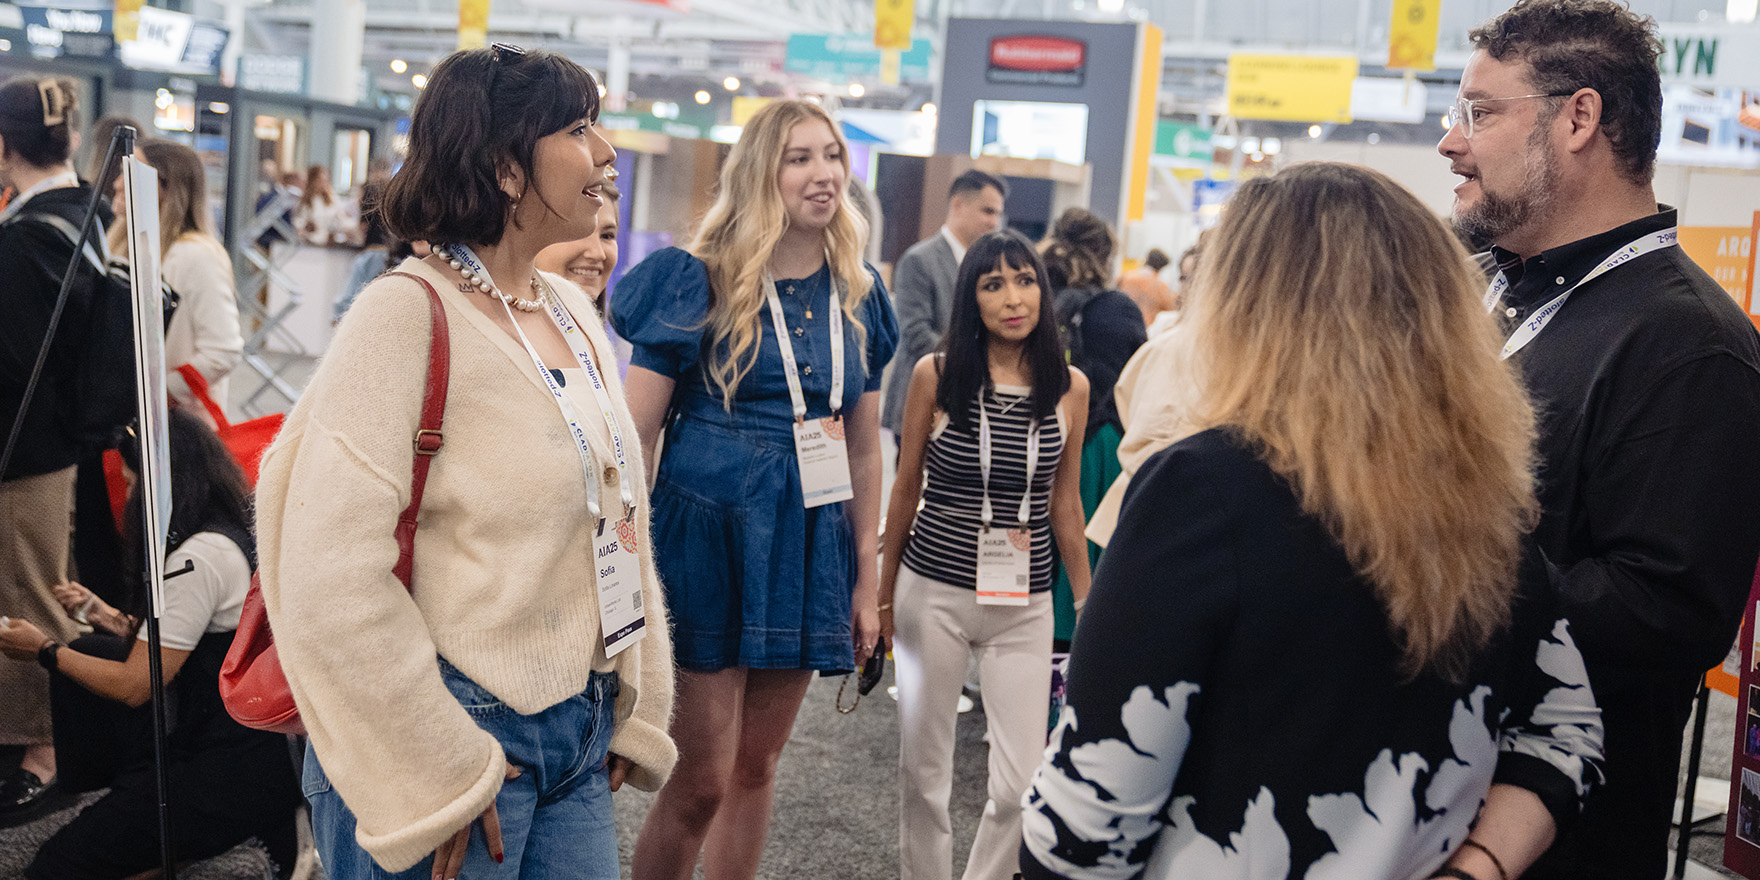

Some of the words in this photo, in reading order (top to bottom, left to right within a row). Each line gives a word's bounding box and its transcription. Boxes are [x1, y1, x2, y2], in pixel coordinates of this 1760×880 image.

[451, 244, 481, 274] Slotted-Z
[579, 351, 601, 390] Slotted-Z
[605, 411, 621, 459] CLADIATOR
[800, 432, 821, 441] AIA25
[576, 428, 593, 478] CLADIATOR
[801, 443, 826, 453] Meredith
[599, 541, 618, 558] AIA25
[600, 565, 615, 578] Sofia
